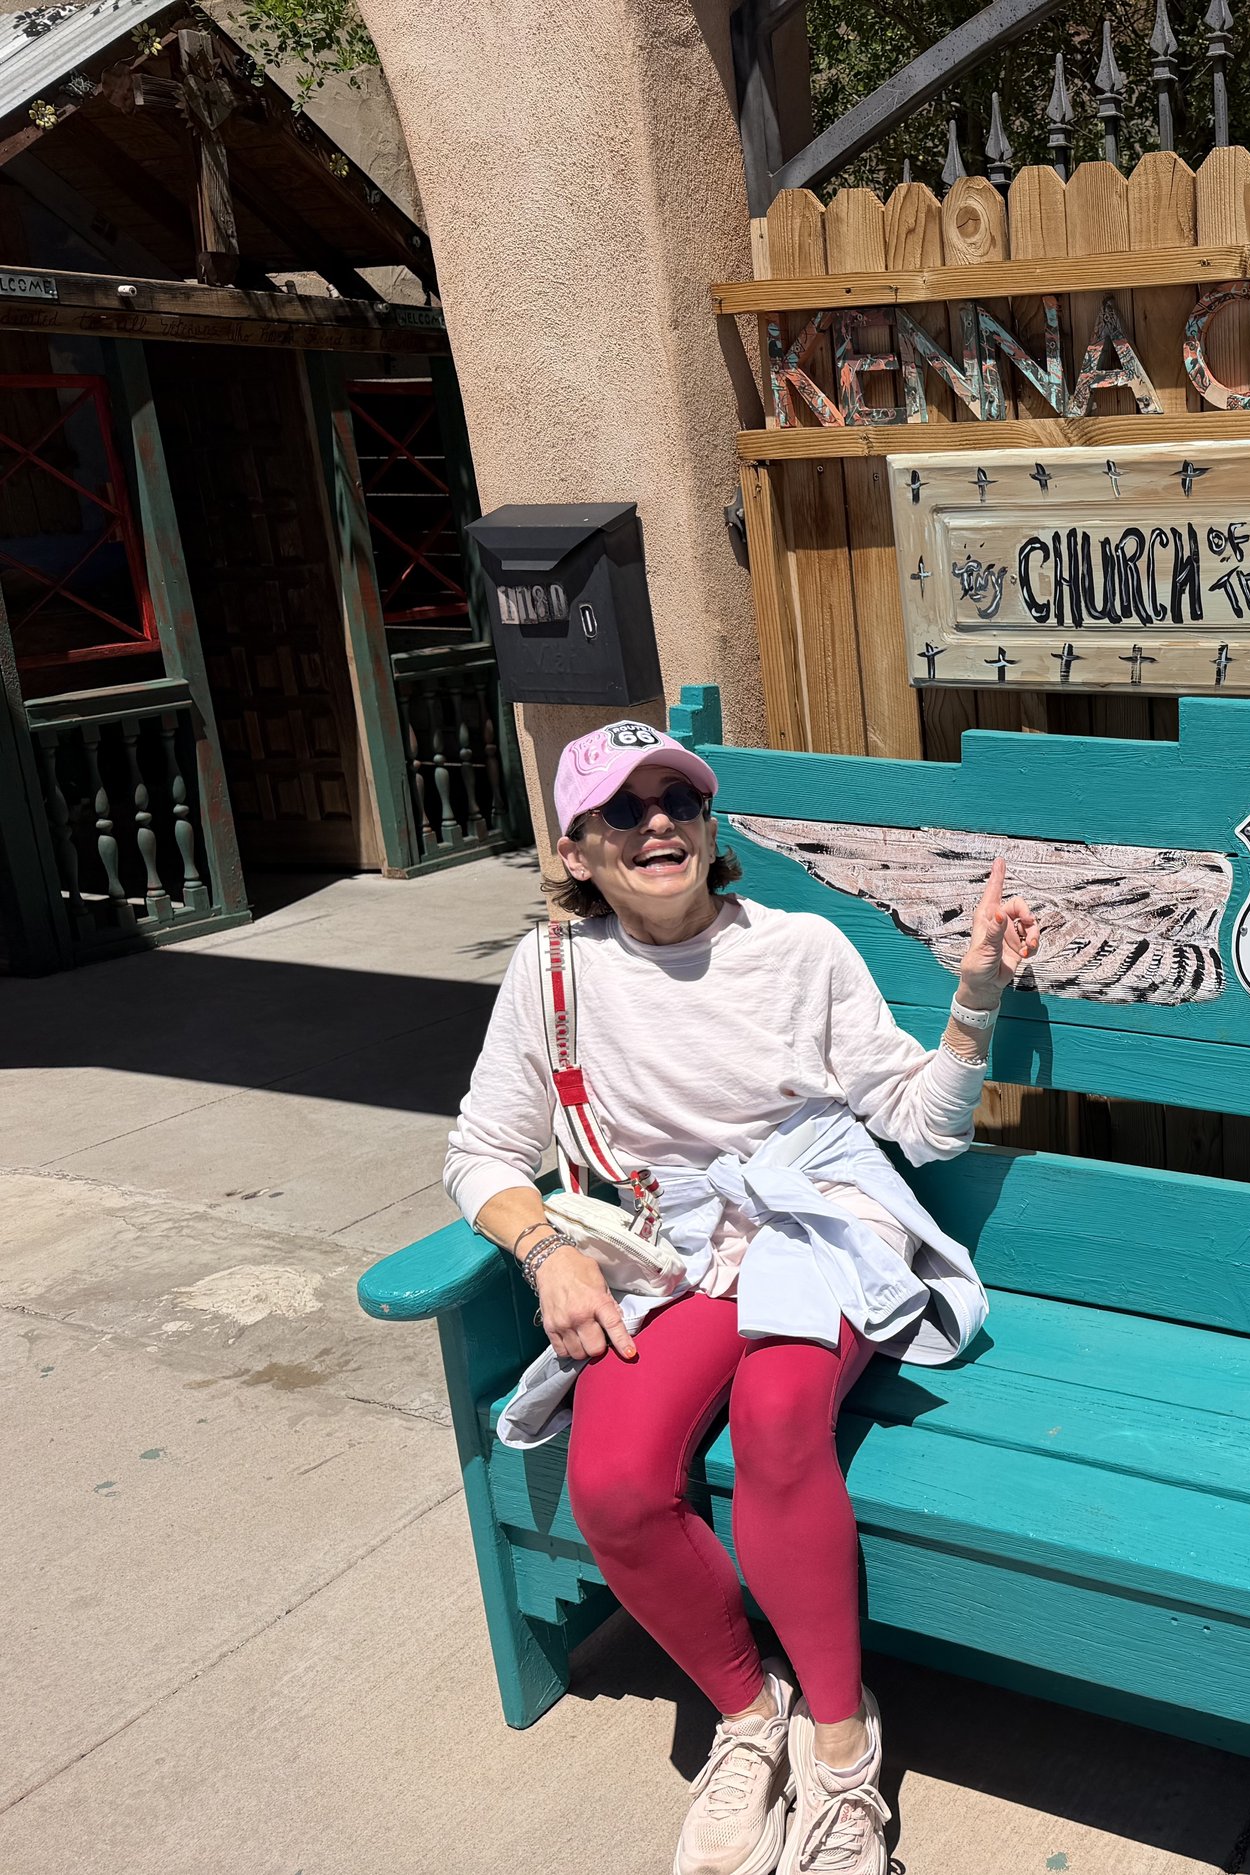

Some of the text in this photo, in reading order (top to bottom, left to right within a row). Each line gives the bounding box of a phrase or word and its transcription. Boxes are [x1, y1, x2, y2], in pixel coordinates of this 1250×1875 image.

[0, 277, 52, 294] LCOME
[398, 311, 444, 328] WELCOM
[765, 293, 1164, 428] KENNA
[1018, 522, 1203, 628] CHURCH
[618, 731, 656, 744] 66
